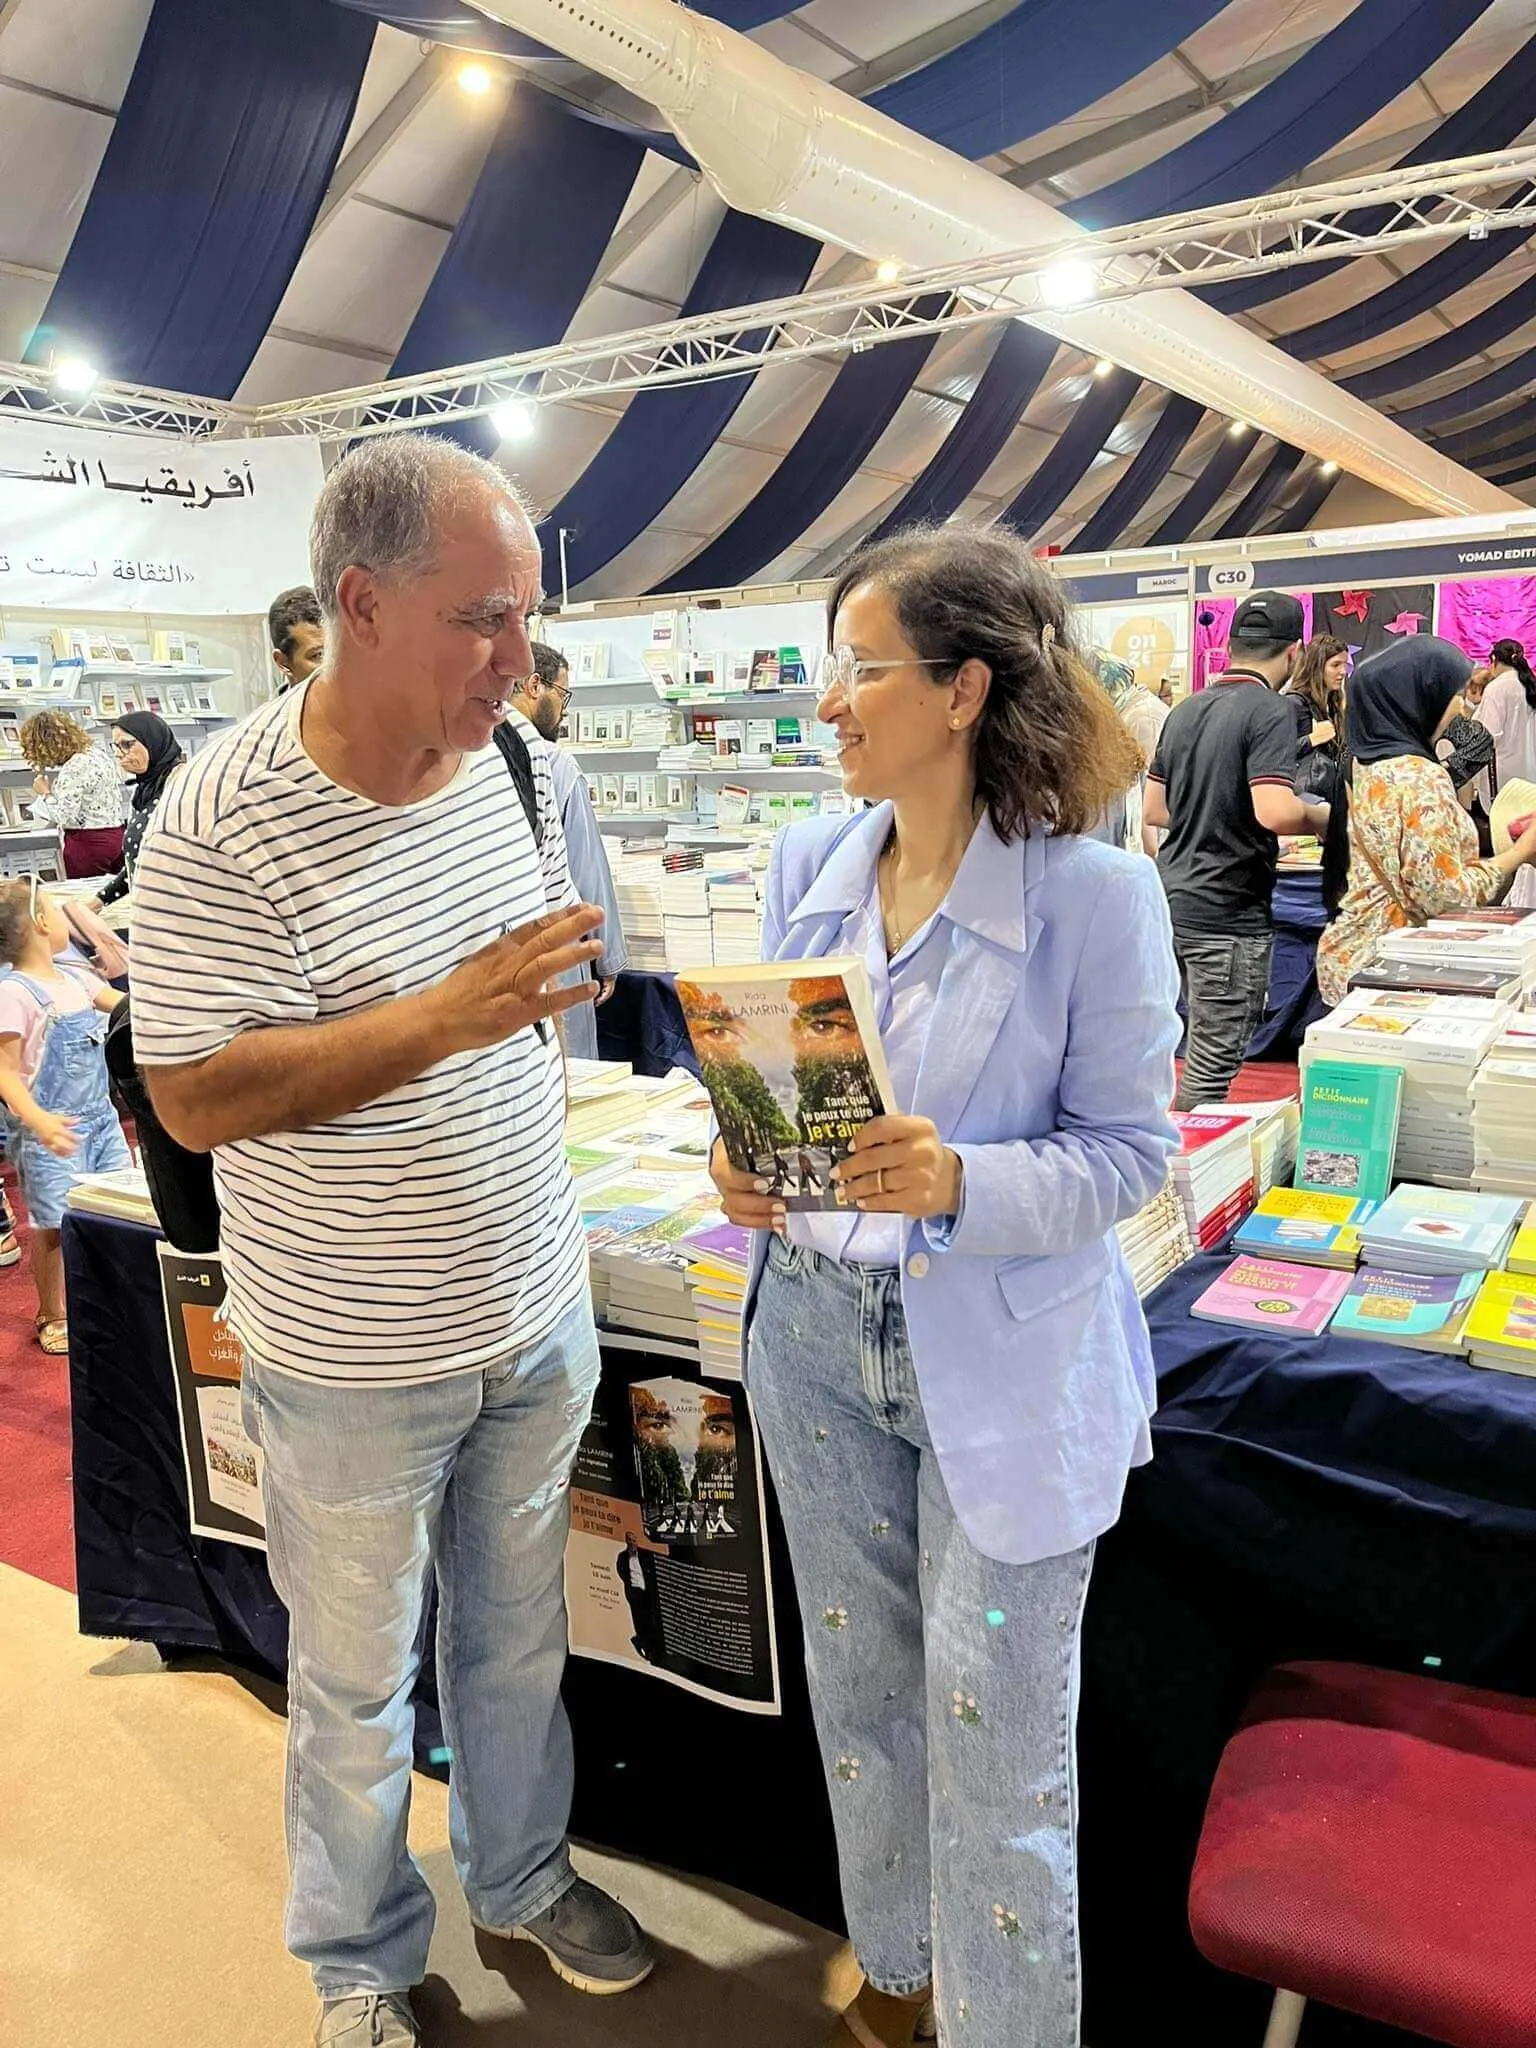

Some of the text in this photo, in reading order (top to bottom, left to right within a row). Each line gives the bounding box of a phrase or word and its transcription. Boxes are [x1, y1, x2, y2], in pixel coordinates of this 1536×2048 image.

[98, 458, 254, 508] أفريقيا
[1458, 551, 1503, 563] YOMAD
[27, 558, 97, 584] ليست
[1216, 570, 1246, 584] C30
[1152, 578, 1176, 586] MAROC
[732, 1003, 789, 1017] LAMRINI
[824, 1095, 870, 1109] Tant que
[802, 1106, 874, 1124] je peux te dire
[807, 1123, 823, 1142] je
